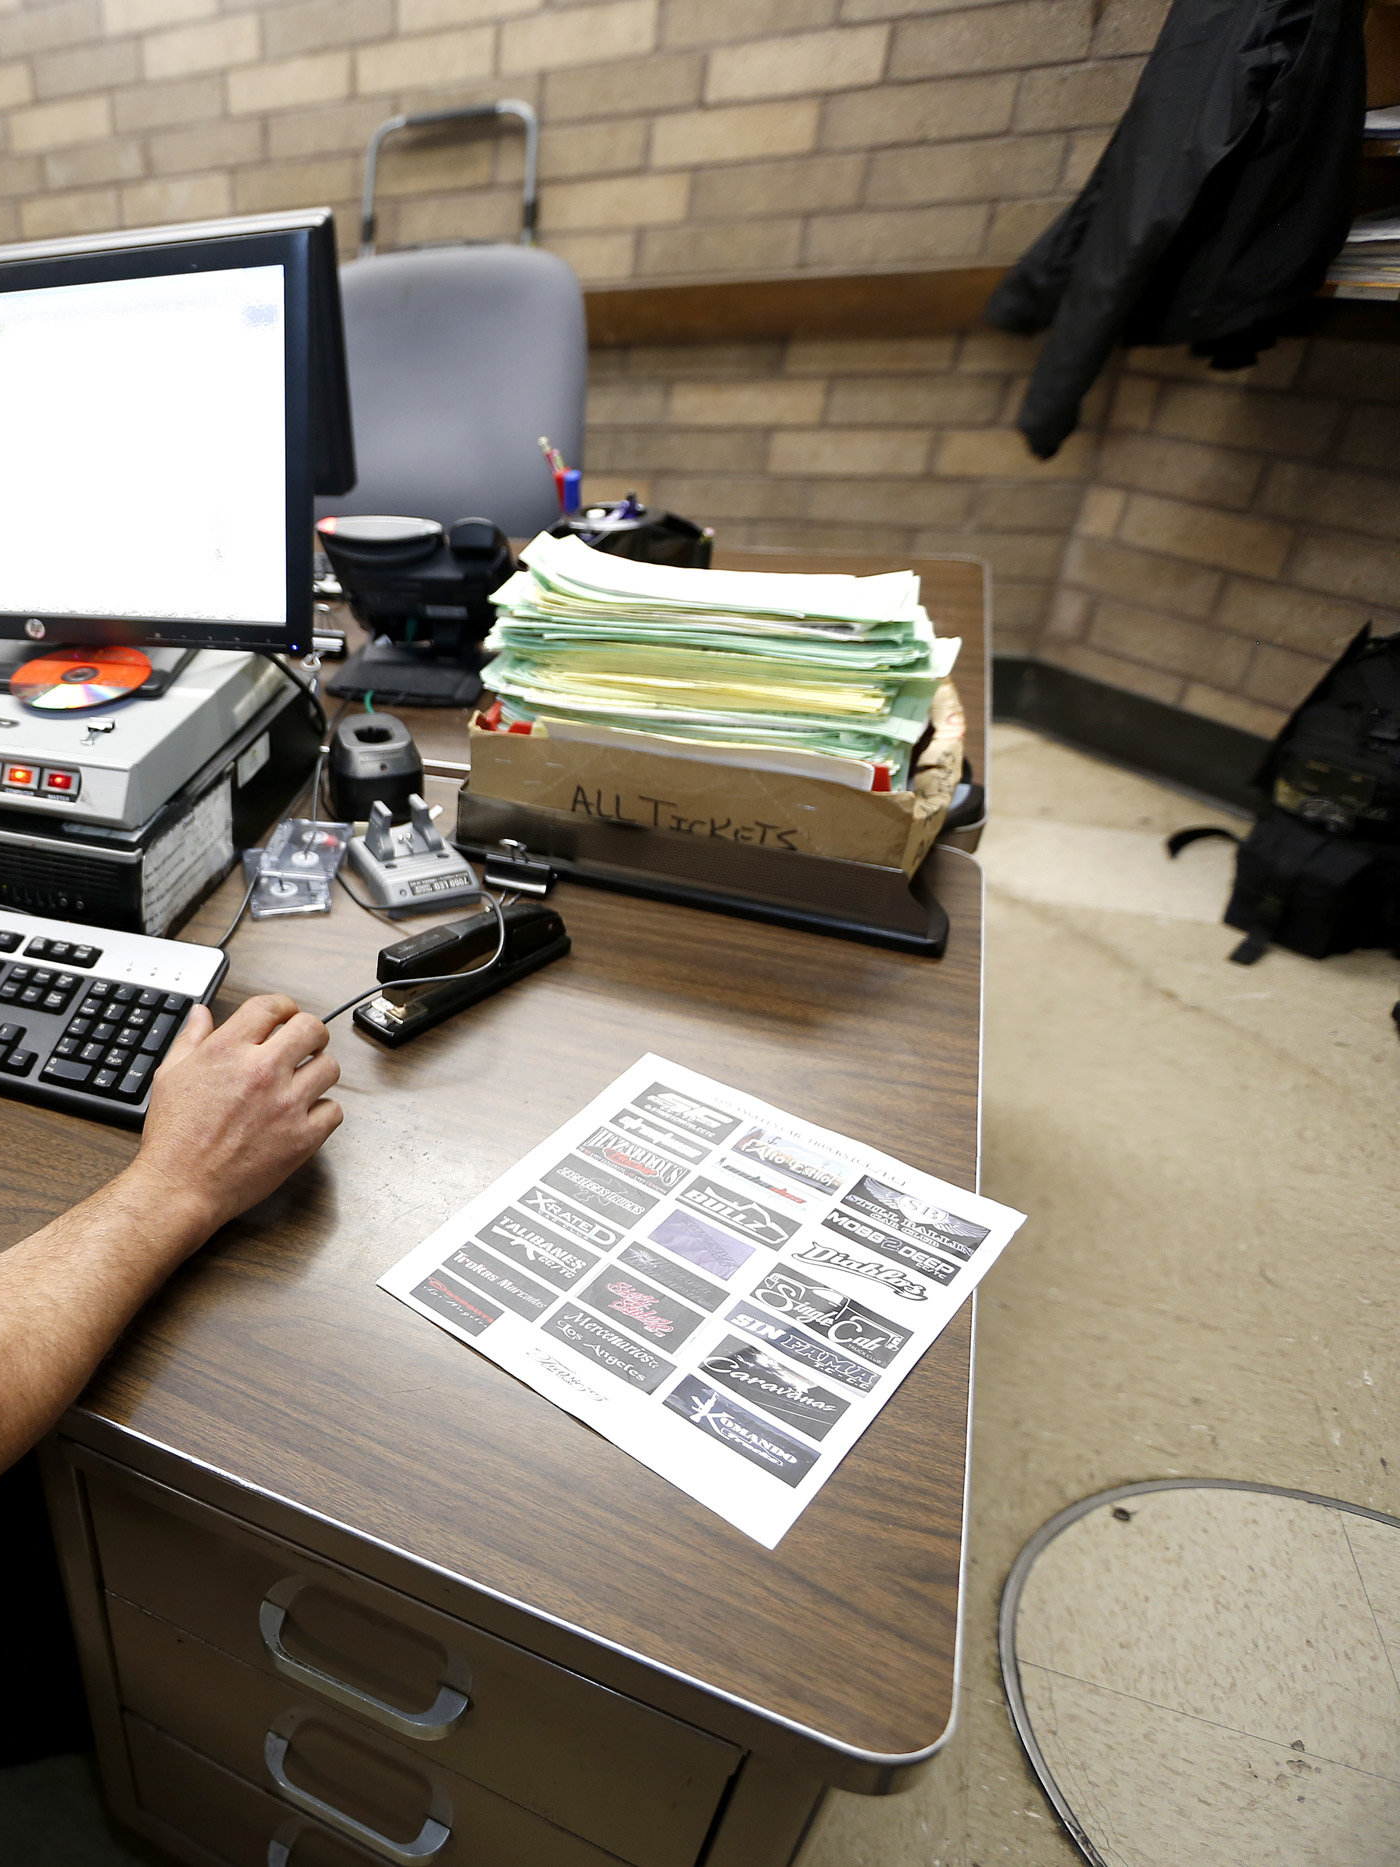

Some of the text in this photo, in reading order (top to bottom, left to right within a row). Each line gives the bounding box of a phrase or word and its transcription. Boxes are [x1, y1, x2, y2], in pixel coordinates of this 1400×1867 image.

[5, 788, 34, 796] COMPUTER
[47, 793, 70, 801] MASTER
[571, 784, 801, 851] ALL TICKETS
[584, 1128, 683, 1187] HAZARDOUS
[538, 1210, 590, 1240] CAR CLUB
[610, 1189, 646, 1215] TRUCKS
[684, 1189, 765, 1231] BULLZ
[846, 1194, 975, 1256] STILL BALLIN
[500, 1216, 586, 1269] TALIBANES
[870, 1213, 940, 1248] CAR CLUB
[797, 1242, 928, 1297] Diablos
[916, 1262, 948, 1280] CC/TC
[564, 1312, 654, 1364] Mercenarios
[755, 1283, 886, 1352] Single Cab
[557, 1320, 646, 1382] Los Angeles
[730, 1313, 877, 1383] SIN FAMA
[848, 1343, 866, 1357] TRUCK
[704, 1356, 838, 1412] Caravanas
[690, 1392, 798, 1464] KOMANDO
